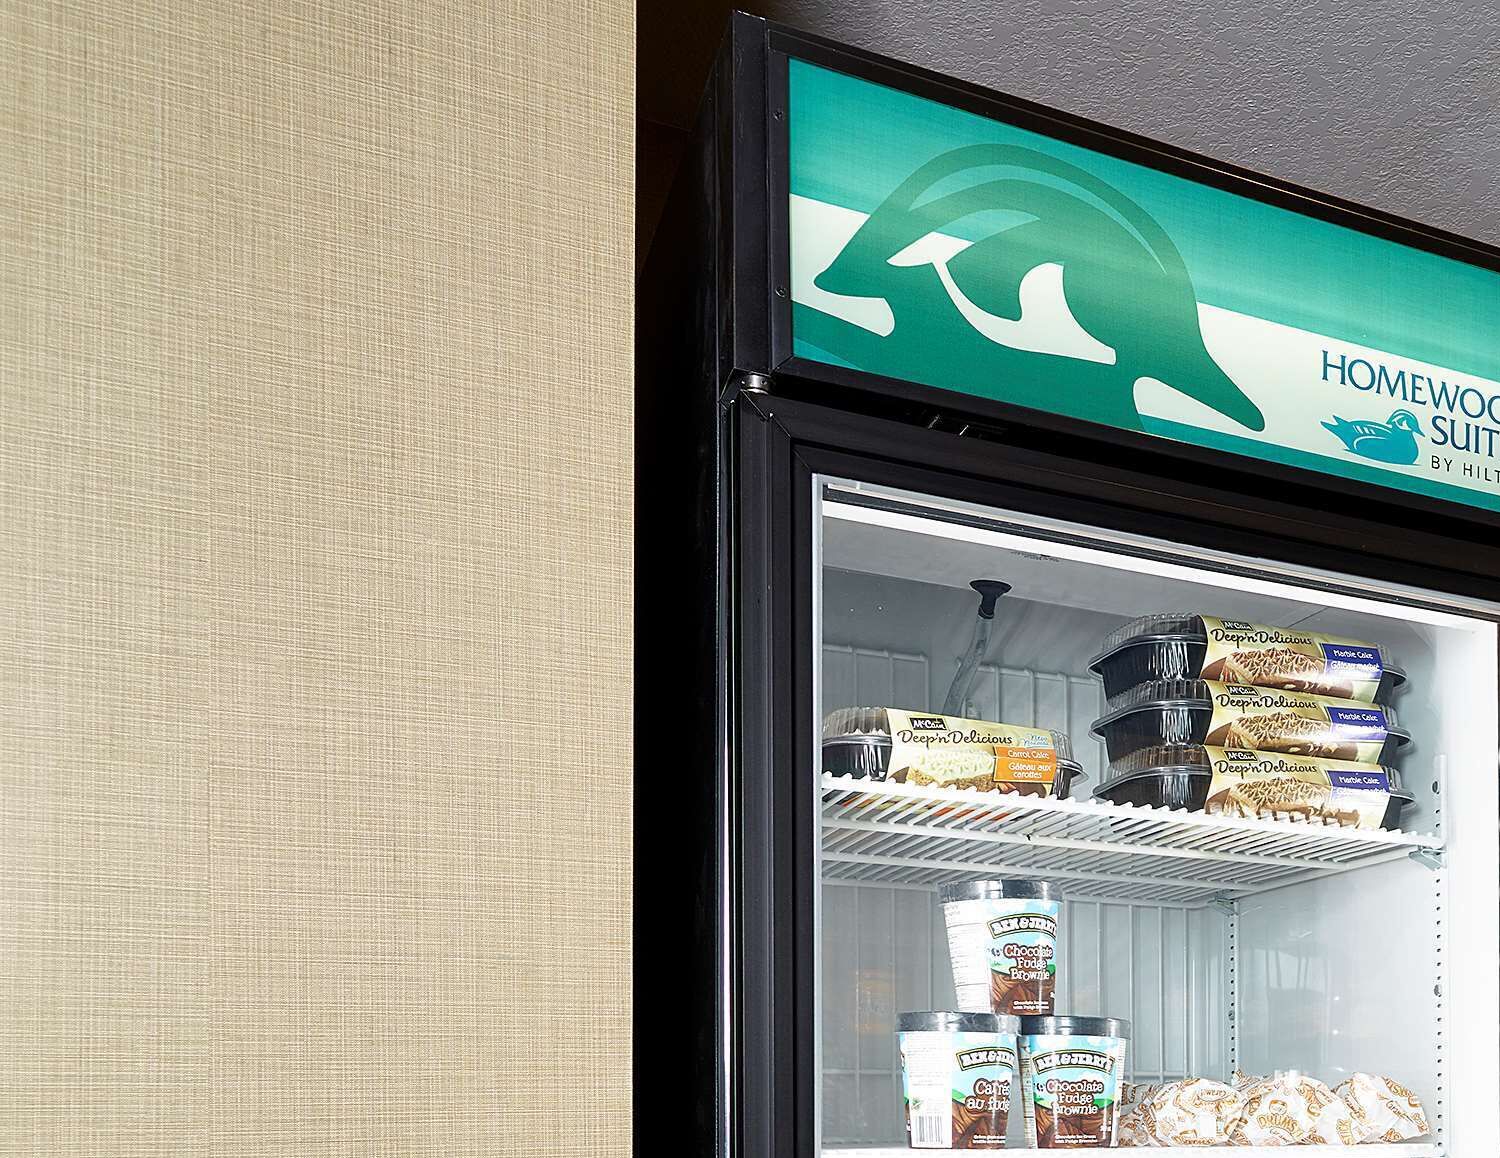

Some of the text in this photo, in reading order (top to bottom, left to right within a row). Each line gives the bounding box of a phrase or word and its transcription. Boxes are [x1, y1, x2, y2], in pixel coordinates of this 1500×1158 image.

[1431, 455, 1453, 472] BY
[1223, 621, 1252, 631] McCain
[1210, 629, 1312, 648] Deep'n Delicious
[1333, 649, 1373, 660] Marble Cake
[1229, 685, 1258, 696] McCain
[1215, 694, 1317, 713] Deep'n Delicious
[1338, 712, 1379, 722] Marble Cake
[912, 719, 947, 731] McCain
[897, 730, 1013, 750] Deep'n Delicious
[1007, 749, 1050, 759] Carrot Cake
[1228, 751, 1257, 761] McCain
[1008, 762, 1036, 771] Gâteau
[1214, 759, 1317, 778] Deep'n Delicious
[1339, 776, 1380, 785] Marble Cake
[1004, 944, 1053, 958] Chocolate
[1018, 957, 1047, 971] Fudge
[1011, 967, 1050, 981] Brownie
[1047, 1079, 1104, 1094] Chocolate
[967, 1098, 984, 1110] au
[1057, 1092, 1093, 1107] Fudge
[1053, 1102, 1099, 1116] Brownie
